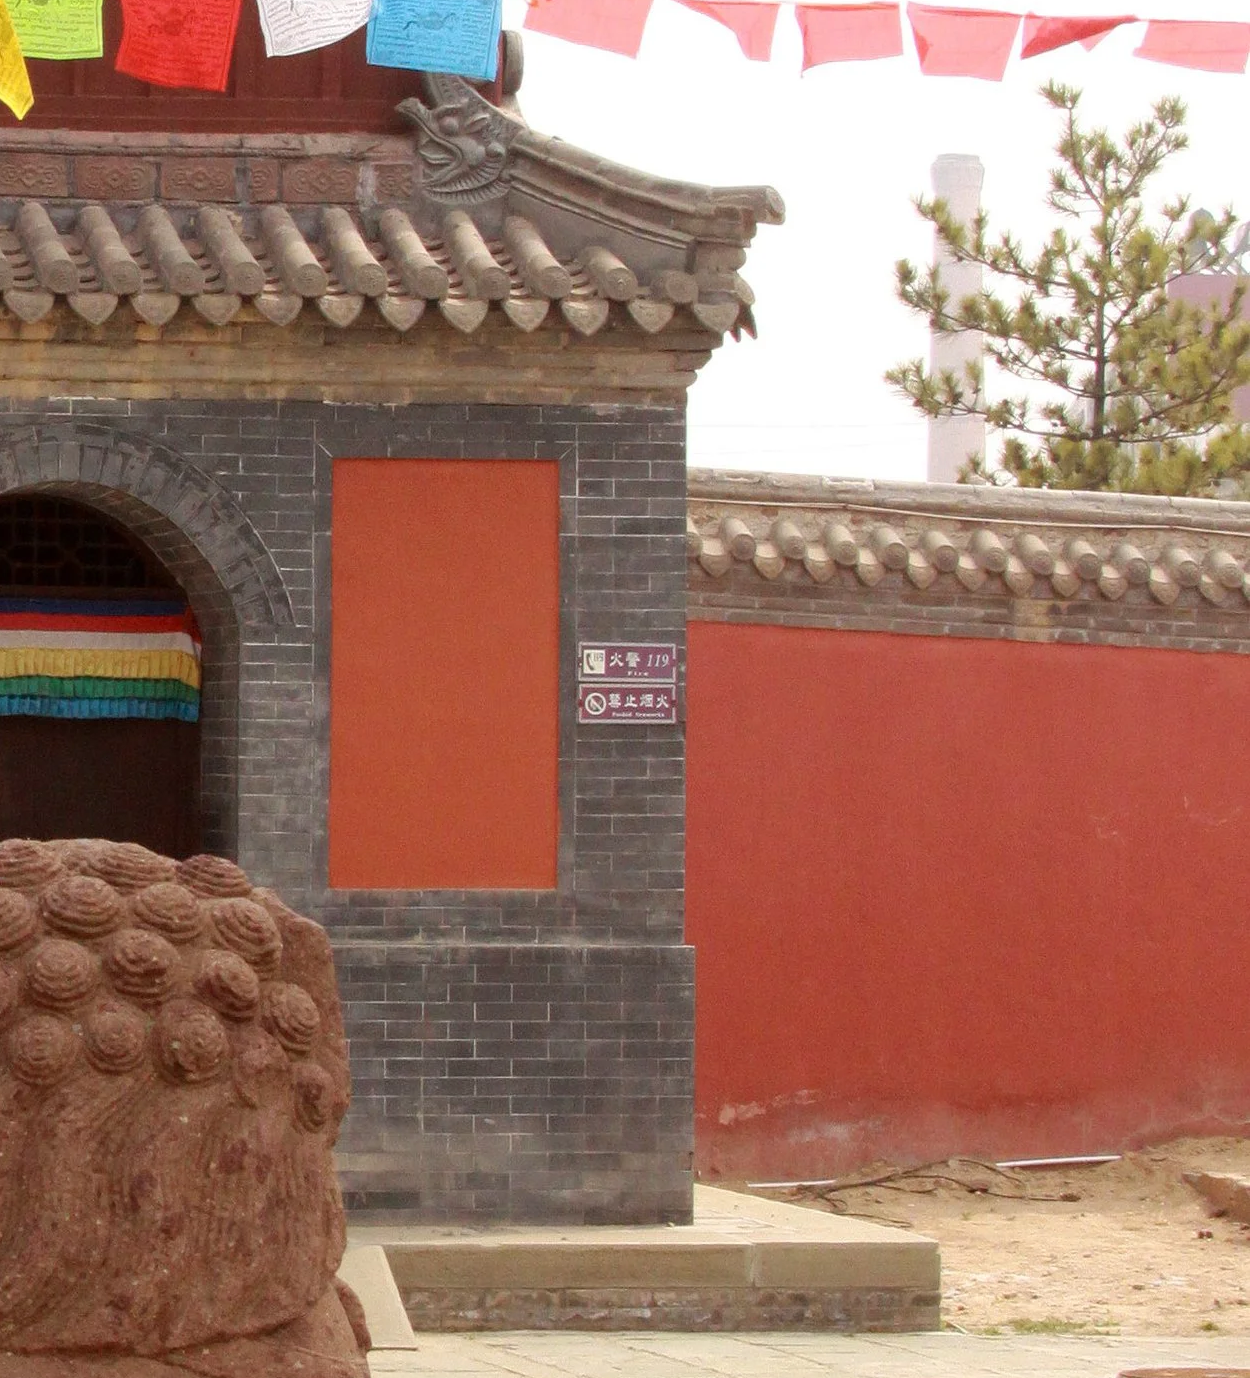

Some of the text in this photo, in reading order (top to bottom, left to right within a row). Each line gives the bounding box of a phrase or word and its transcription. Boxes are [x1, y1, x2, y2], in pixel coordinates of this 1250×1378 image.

[610, 652, 669, 668] 火警 119
[608, 693, 669, 709] 禁止烟火
